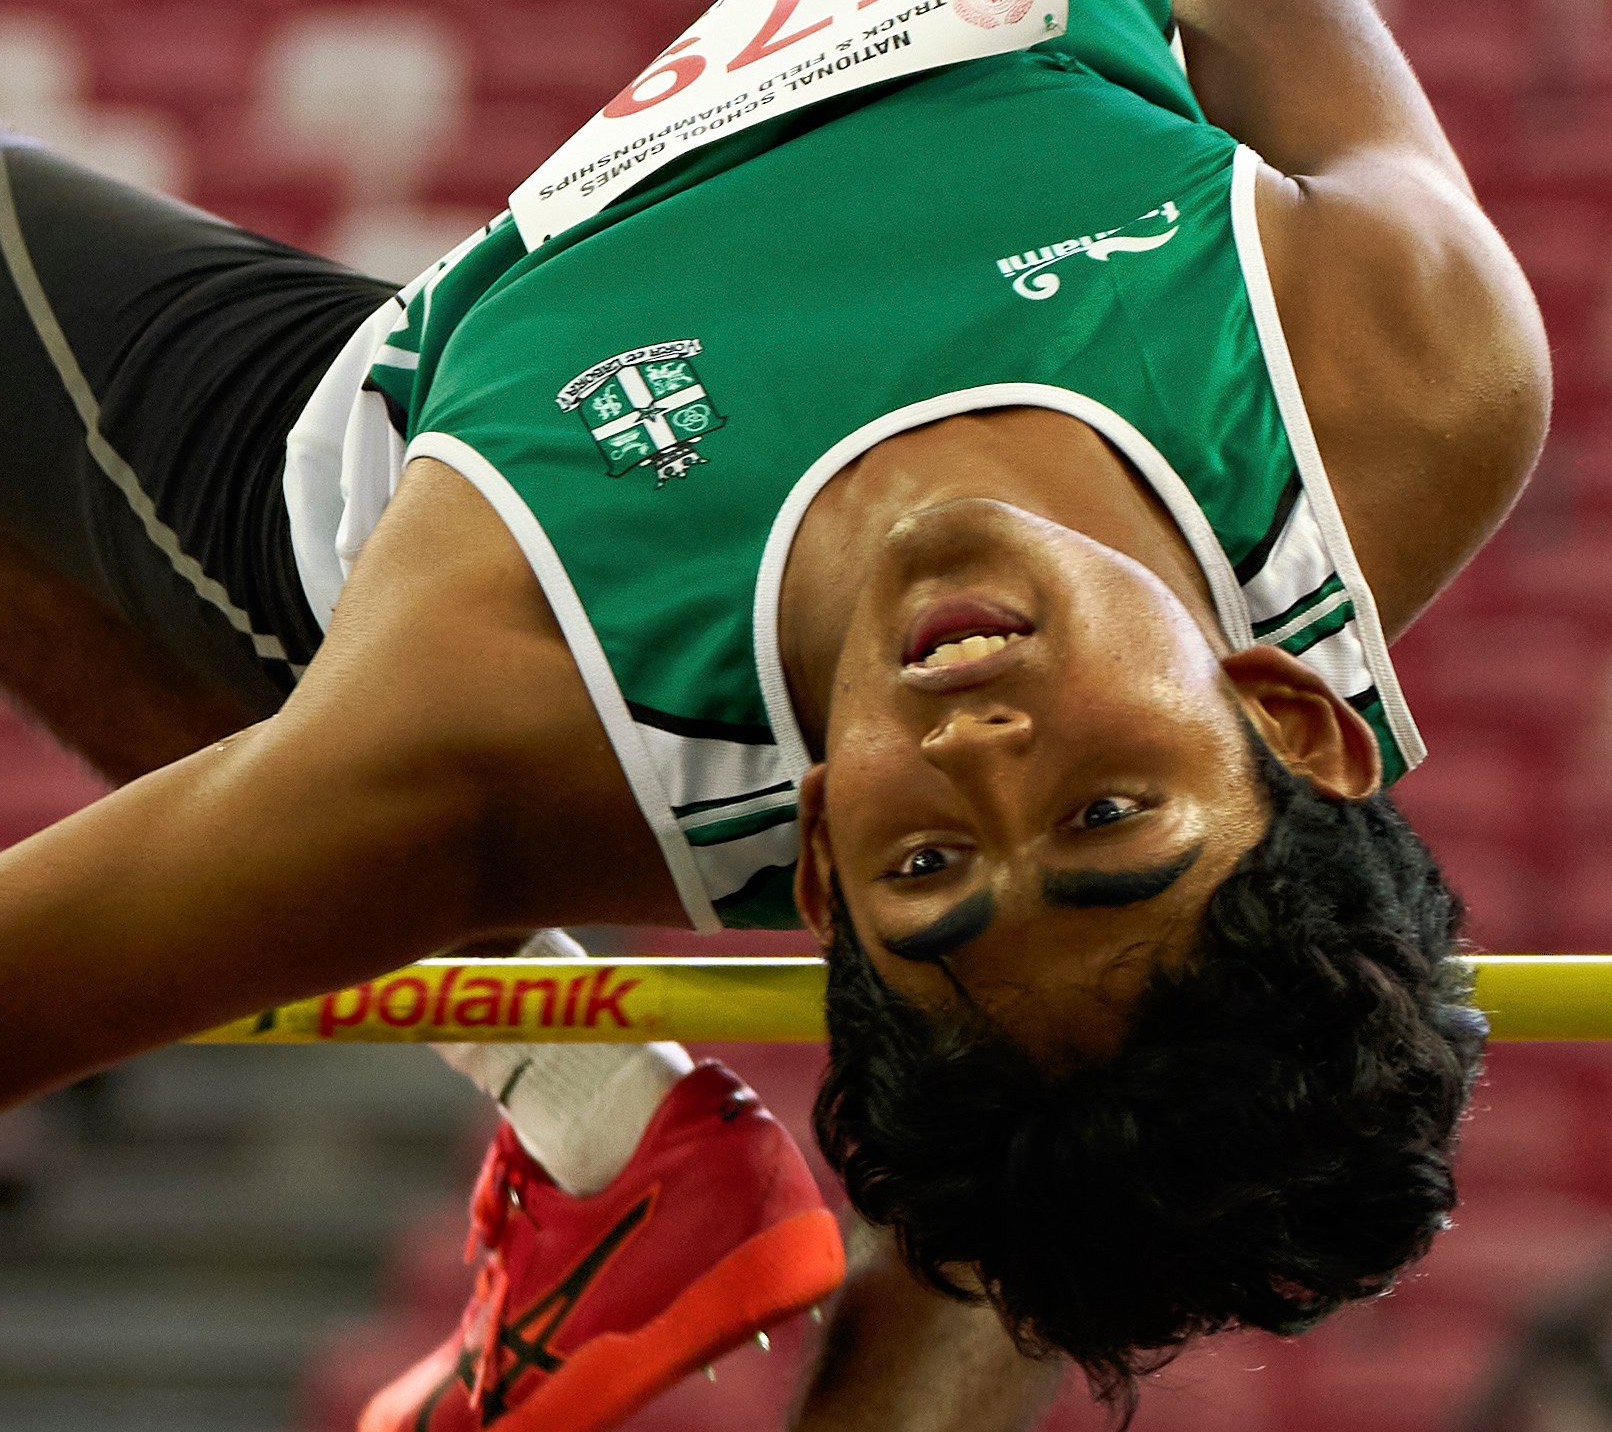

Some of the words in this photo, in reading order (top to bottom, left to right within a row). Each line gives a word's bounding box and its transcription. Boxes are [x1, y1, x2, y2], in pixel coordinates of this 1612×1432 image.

[759, 52, 826, 92] FIELD
[785, 30, 911, 91] NATIONAL
[835, 38, 854, 52] &
[675, 91, 775, 142] SCHOOL
[539, 92, 749, 201] CHAMPIONSHIPS
[580, 142, 666, 197] GAMES
[317, 967, 642, 1038] polanik
